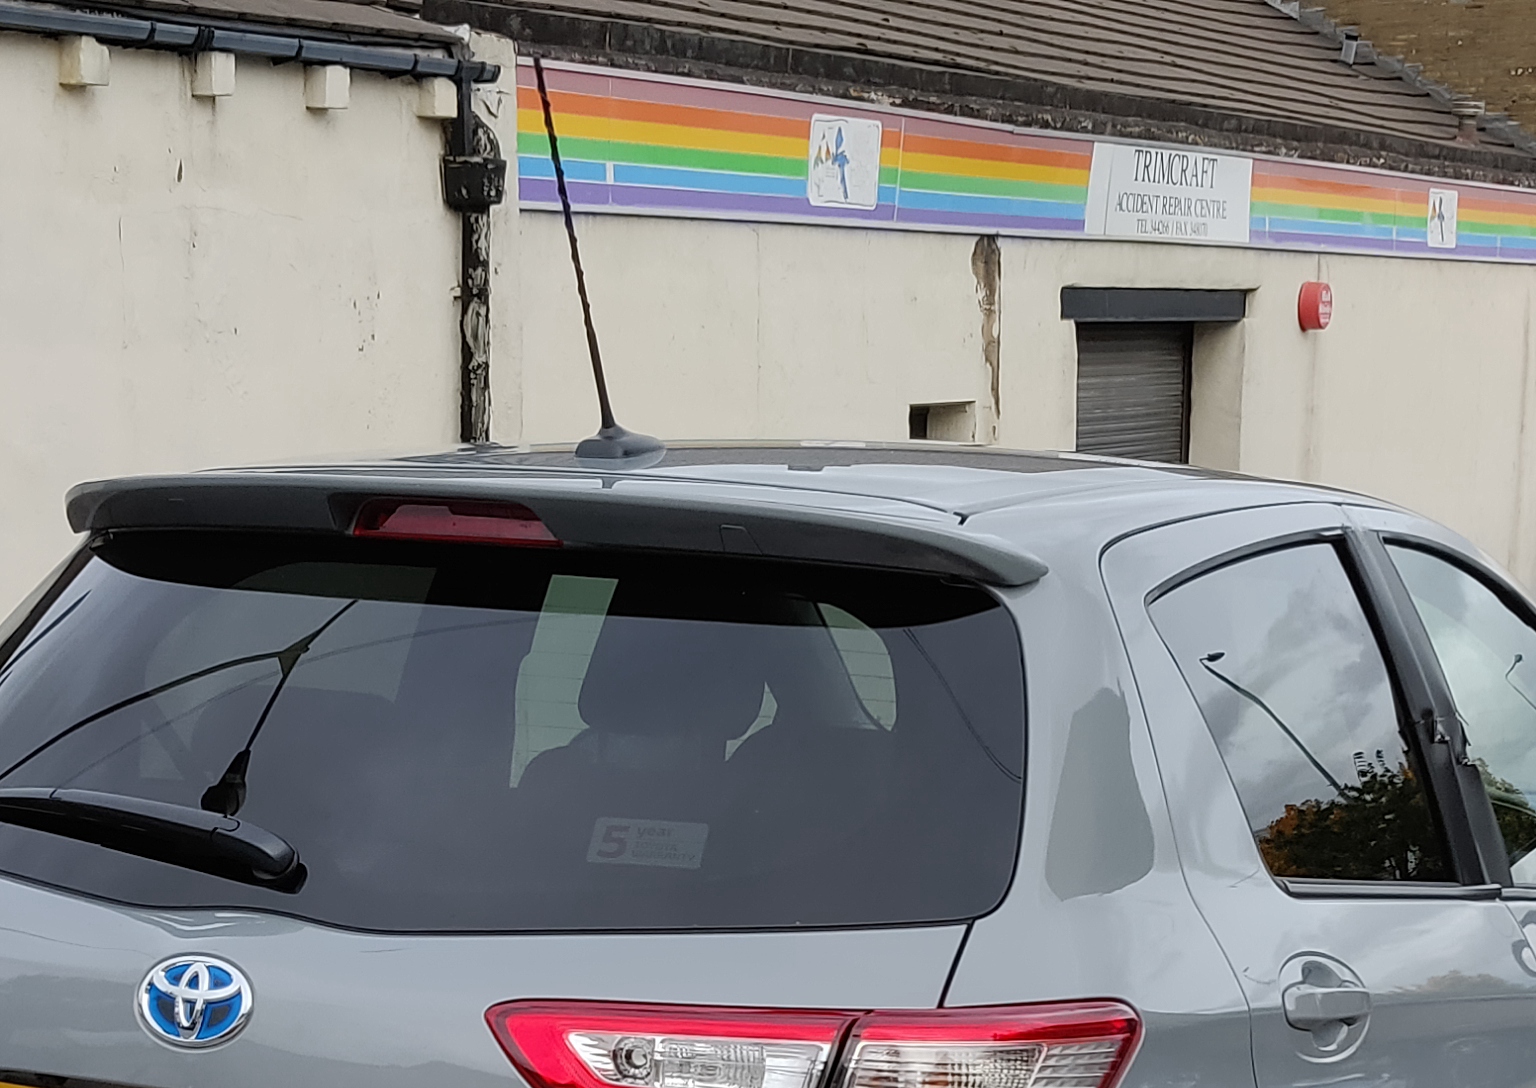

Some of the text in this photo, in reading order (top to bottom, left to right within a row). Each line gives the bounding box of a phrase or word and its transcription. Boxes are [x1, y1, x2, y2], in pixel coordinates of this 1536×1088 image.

[1134, 149, 1218, 189] TRIMCRAFT
[1115, 191, 1227, 220] ACCIDENT REPAIR CENTRE
[1136, 219, 1149, 234] TEL
[1176, 221, 1188, 236] FAX
[597, 825, 630, 858] 5
